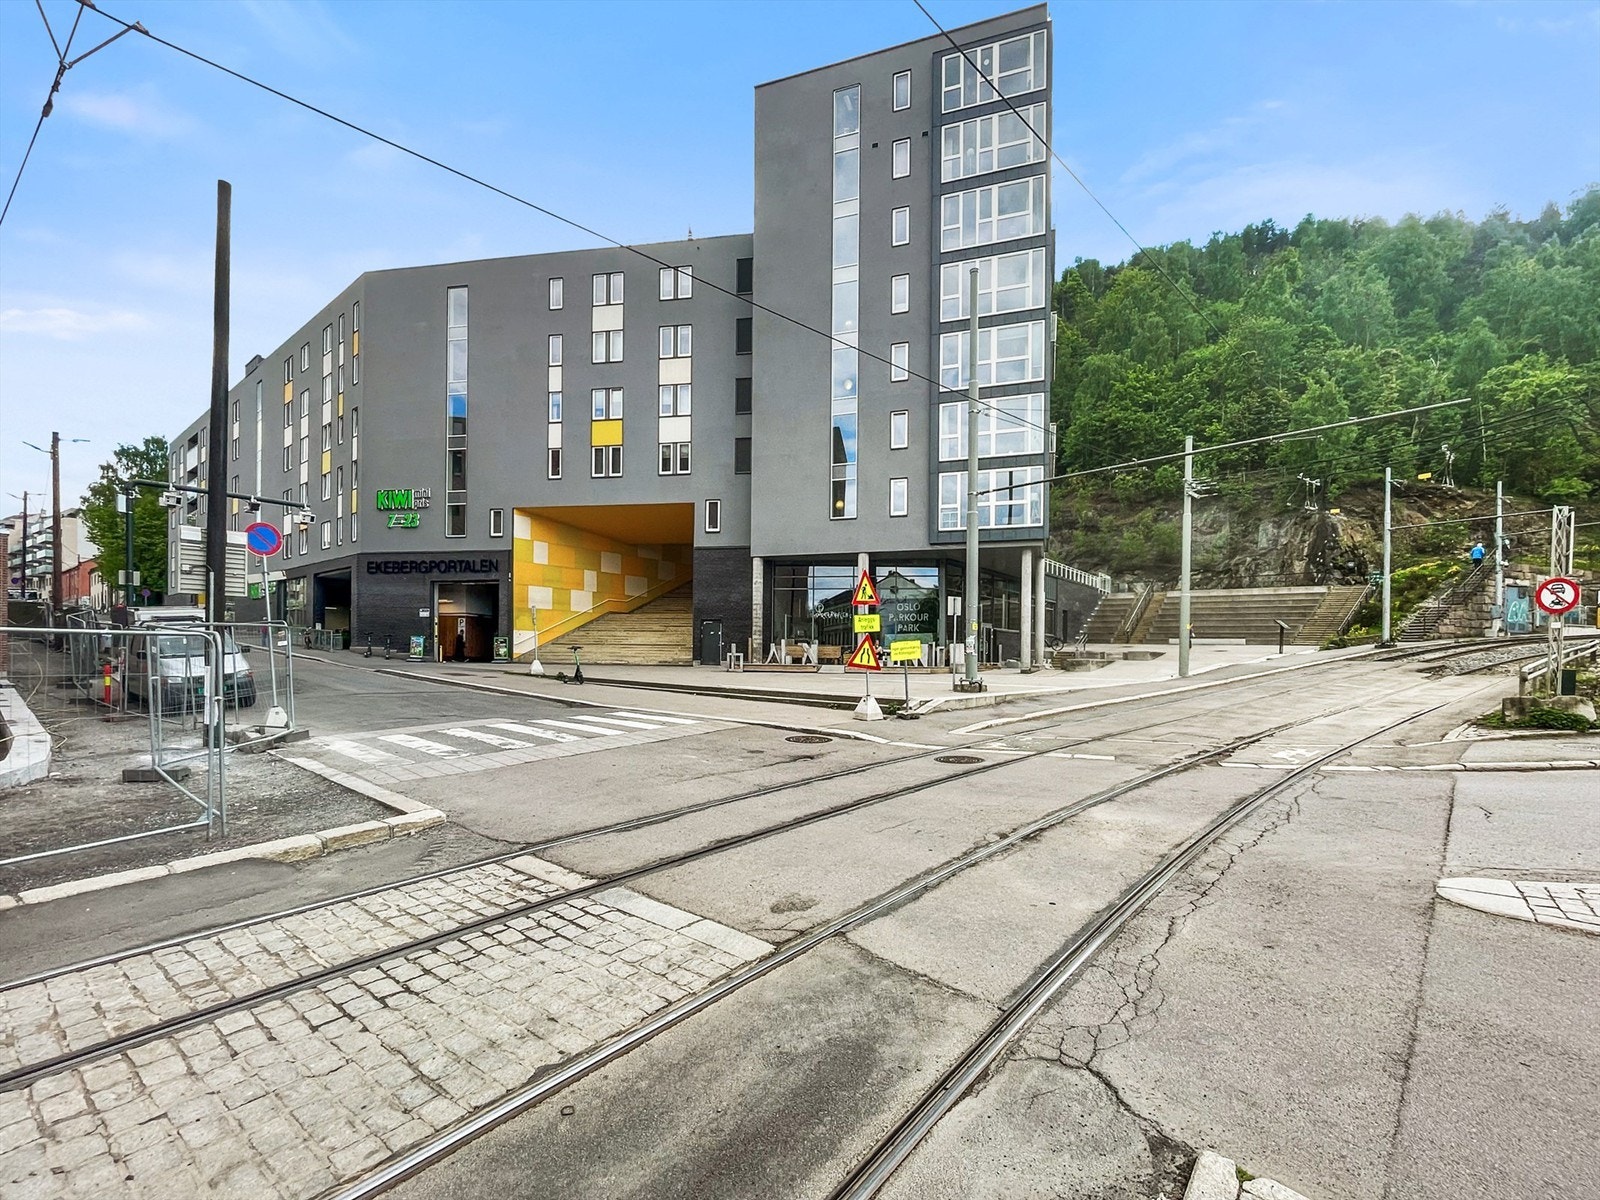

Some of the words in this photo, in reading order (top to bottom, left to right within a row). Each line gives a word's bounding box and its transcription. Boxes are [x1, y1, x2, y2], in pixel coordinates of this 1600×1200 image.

[377, 489, 414, 510] KIWI
[366, 559, 499, 574] EKEBERGPORTALEN
[896, 602, 920, 611] OSLO
[897, 623, 920, 632] PARK
